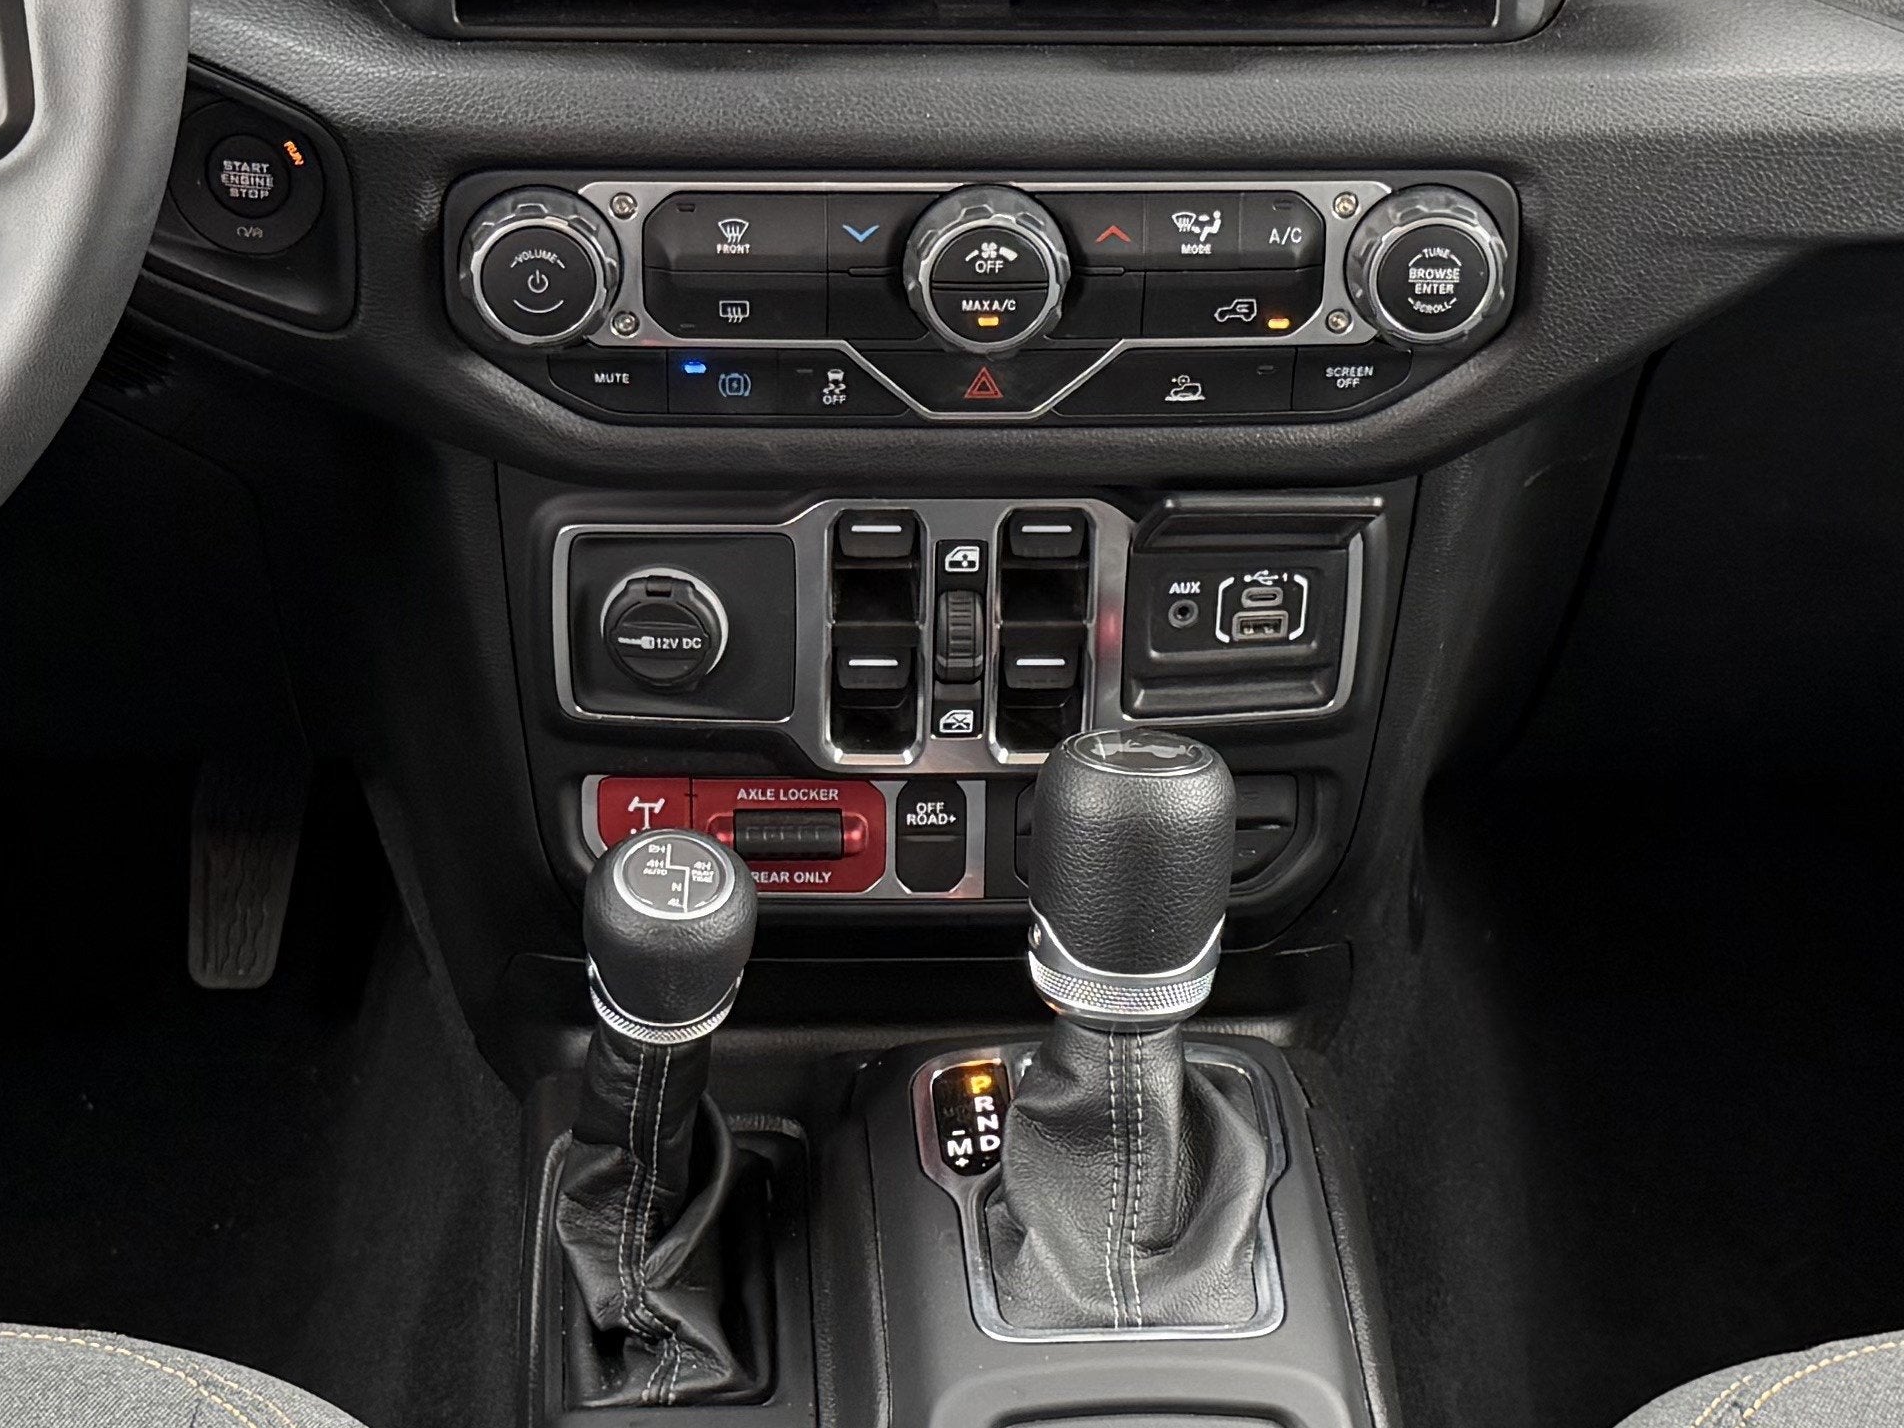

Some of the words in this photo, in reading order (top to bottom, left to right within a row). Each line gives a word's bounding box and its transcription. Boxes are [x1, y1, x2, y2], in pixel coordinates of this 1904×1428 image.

[222, 160, 270, 174] START
[220, 173, 274, 187] ENGINE
[229, 187, 270, 200] STOP
[1268, 227, 1302, 245] A/C
[716, 243, 751, 255] FRONT
[1180, 243, 1213, 255] MODE
[1422, 247, 1450, 259] TUNE
[514, 249, 559, 265] VOLUME
[974, 260, 1004, 274] OFF
[1408, 267, 1461, 280] BROWSE
[1414, 282, 1455, 295] ENTER
[961, 299, 990, 312] MAX
[992, 298, 1017, 312] A/C
[1412, 299, 1454, 315] SCROLL
[594, 372, 630, 384] MUTE
[1325, 365, 1375, 378] SCREEN
[1336, 377, 1361, 389] OFF
[822, 394, 847, 405] OFF
[1168, 581, 1202, 595] AUX
[656, 637, 679, 649] 12V
[681, 637, 702, 649] DC
[736, 788, 776, 801] AXLE
[778, 788, 839, 801] LOCKER
[915, 801, 946, 815] OFF
[905, 812, 958, 827] ROAD+
[645, 859, 664, 868] 4H
[750, 871, 791, 884] REAR
[793, 871, 833, 884] ONLY
[671, 882, 683, 892] N
[667, 897, 684, 909] 4L
[969, 1074, 993, 1095] P
[973, 1095, 995, 1113] R
[976, 1113, 999, 1132] N
[946, 1137, 974, 1158] M
[979, 1134, 1001, 1152] D
